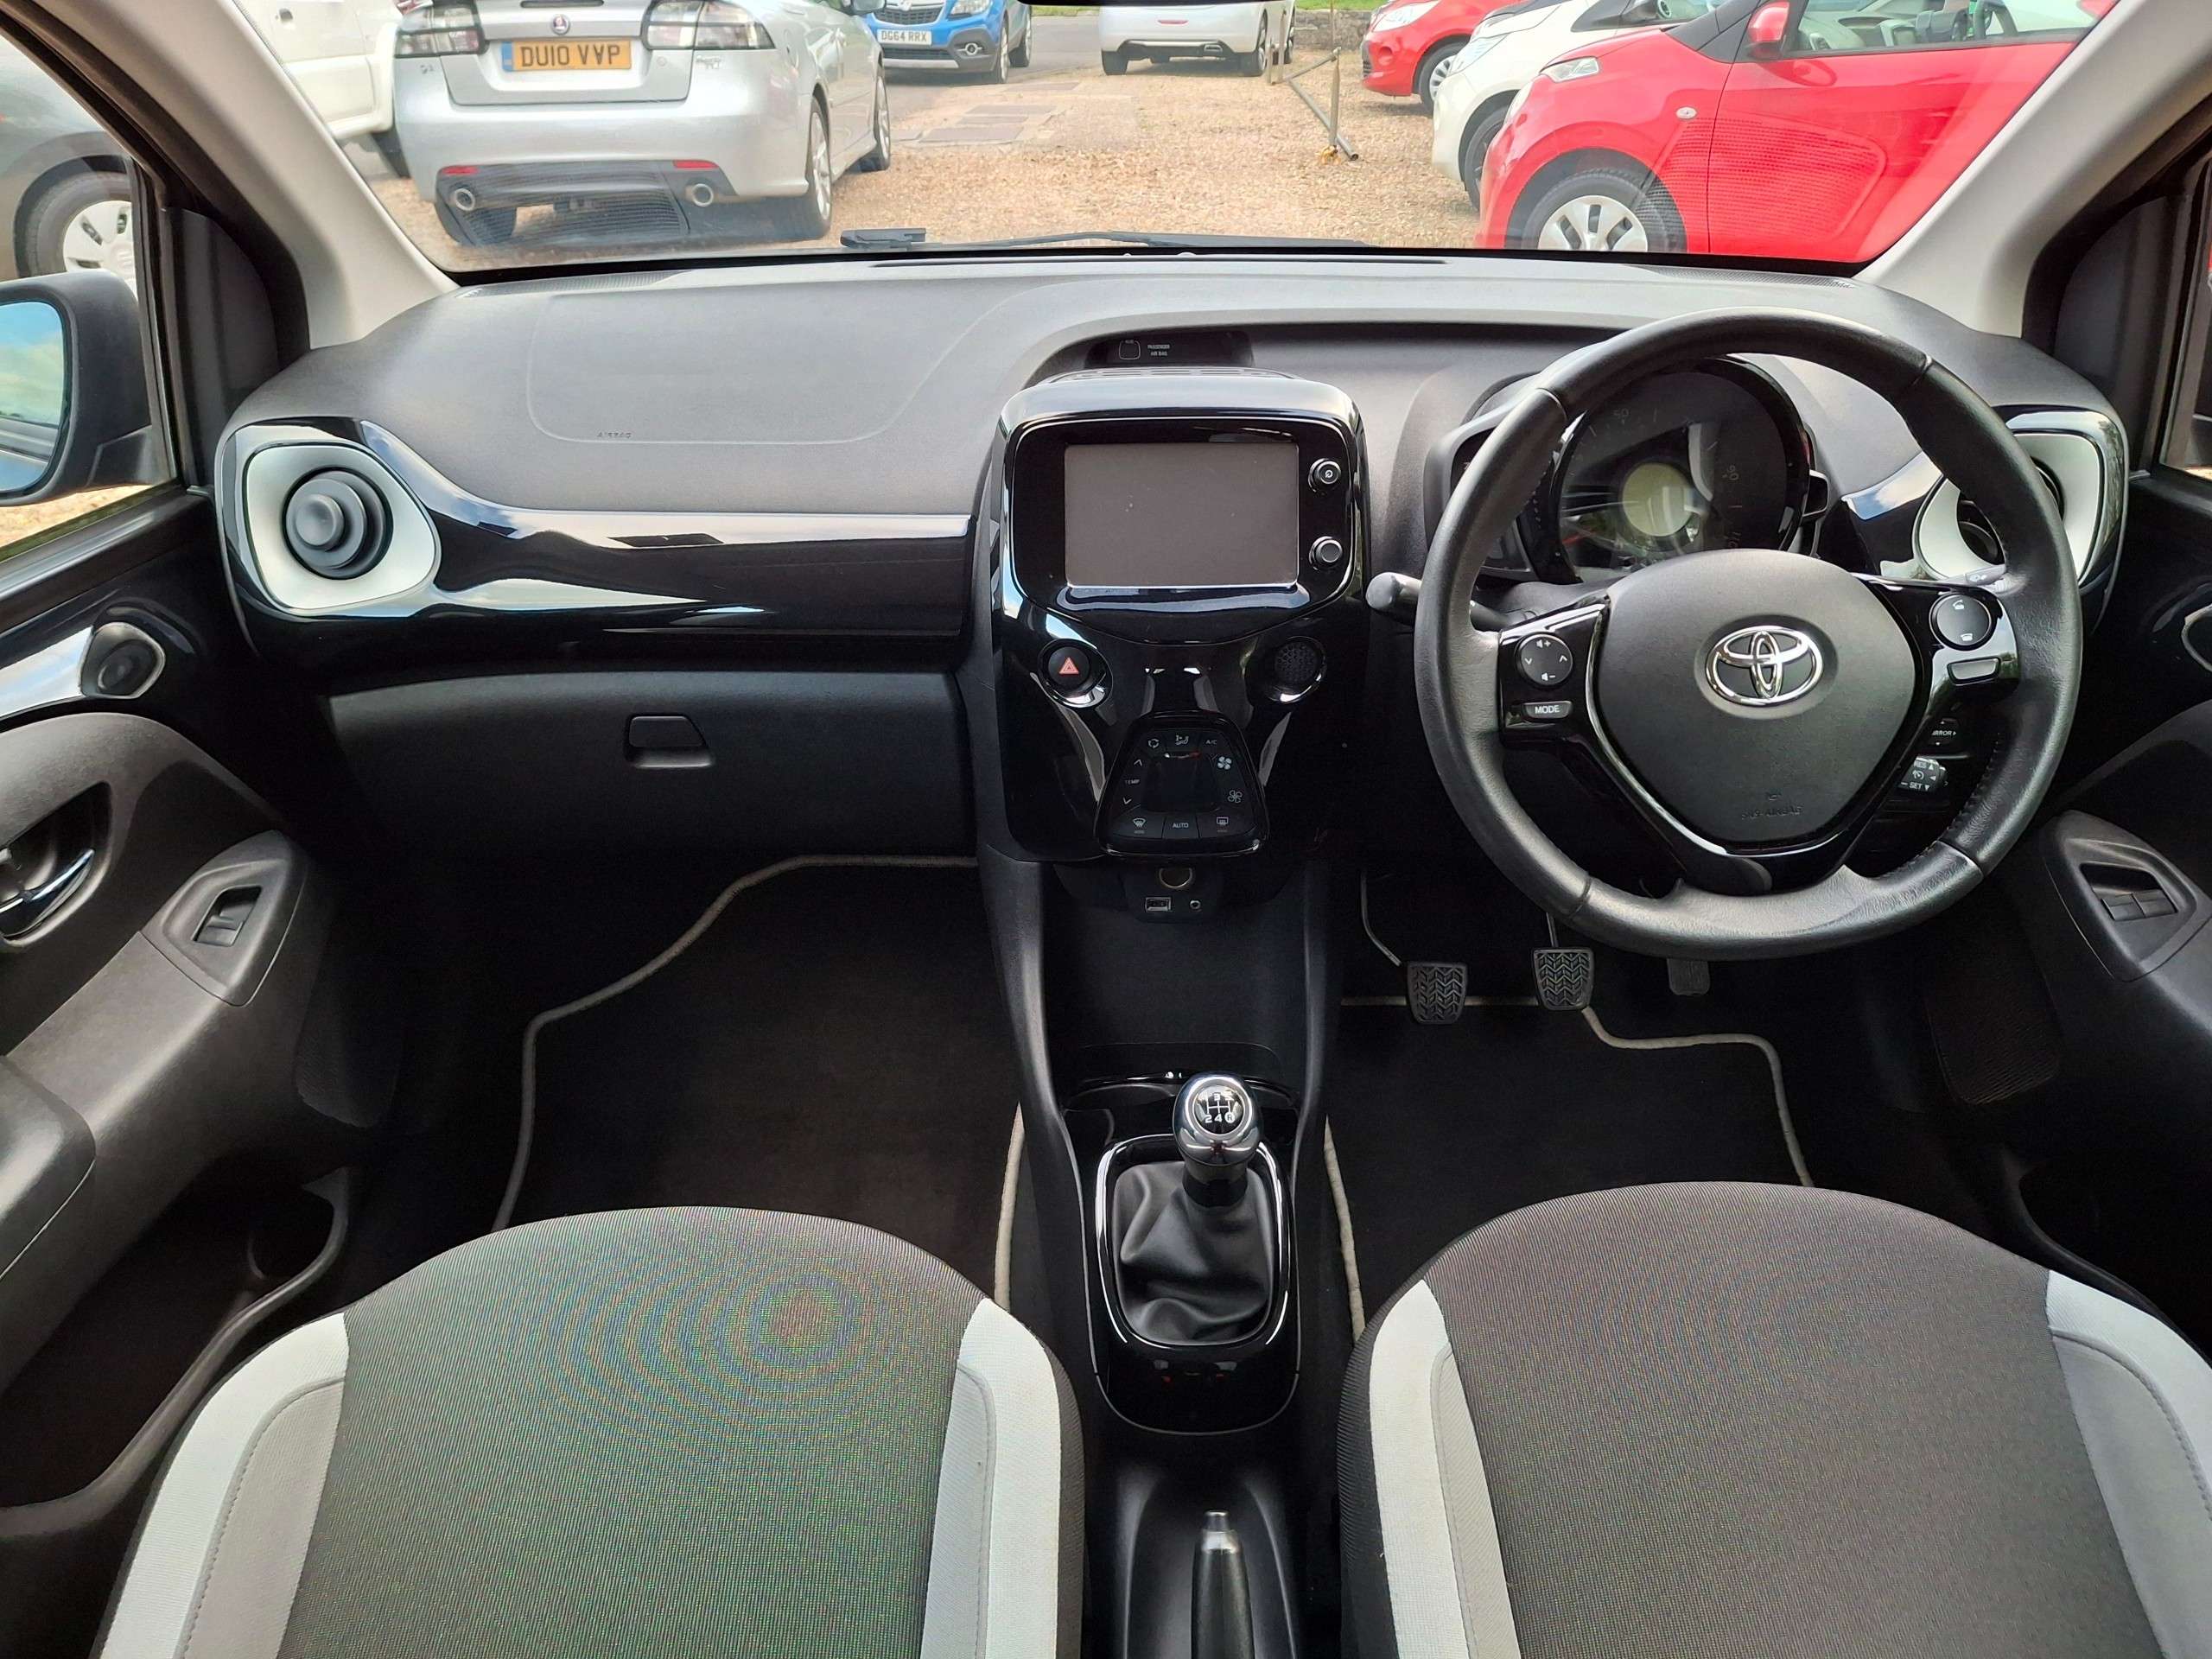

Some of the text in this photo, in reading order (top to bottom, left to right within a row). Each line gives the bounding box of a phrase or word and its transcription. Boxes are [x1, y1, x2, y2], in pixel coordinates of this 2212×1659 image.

[520, 46, 570, 67] DU10
[1535, 704, 1560, 715] MODE
[1909, 781, 1923, 790] SET
[1213, 1092, 1221, 1102] 3
[1205, 1114, 1213, 1123] 2
[1214, 1113, 1223, 1122] 4
